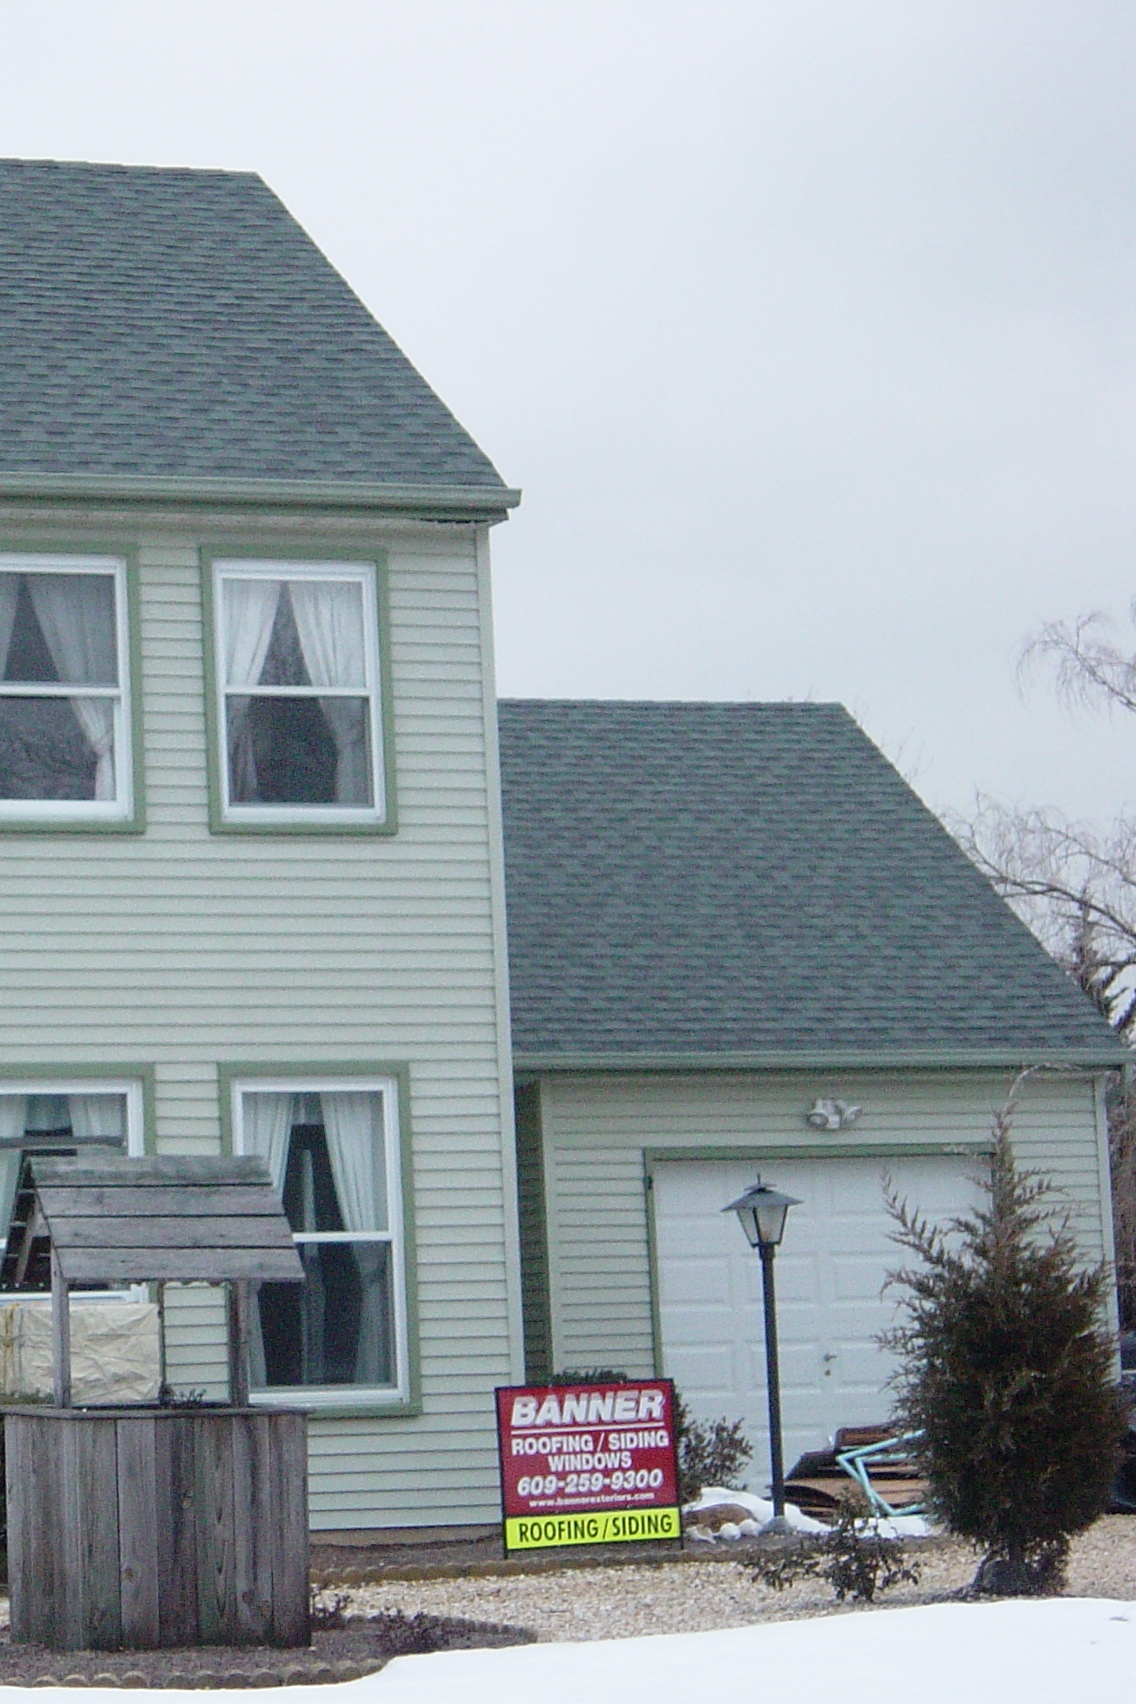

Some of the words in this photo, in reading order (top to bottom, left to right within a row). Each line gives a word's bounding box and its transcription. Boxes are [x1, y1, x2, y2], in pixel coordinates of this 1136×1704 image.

[510, 1389, 665, 1427] BANNER
[511, 1434, 594, 1456] ROOFING
[608, 1431, 670, 1450] SIDING
[548, 1451, 633, 1472] WINDOWS
[517, 1469, 664, 1497] 609-259-9300
[518, 1518, 599, 1543] ROOFING
[612, 1514, 673, 1537] SIDING
